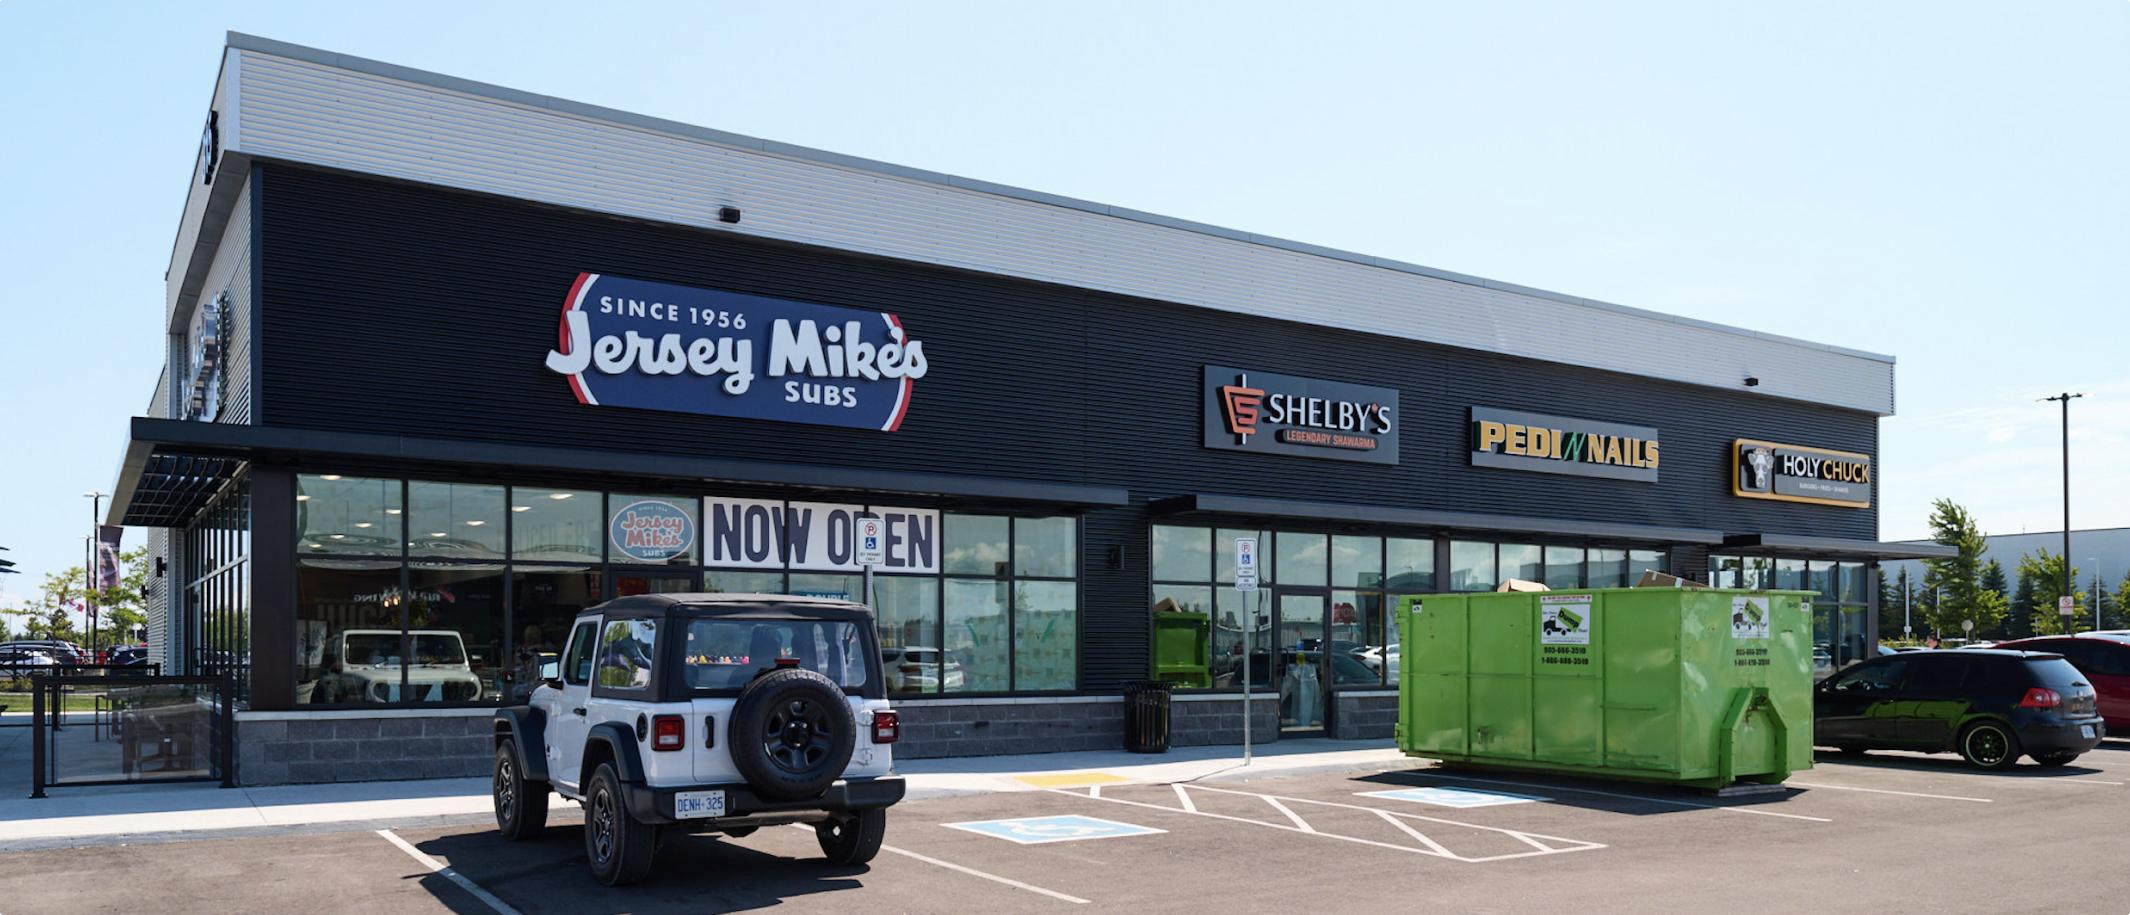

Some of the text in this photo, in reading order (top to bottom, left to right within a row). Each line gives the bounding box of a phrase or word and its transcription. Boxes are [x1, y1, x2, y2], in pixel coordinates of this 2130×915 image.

[600, 296, 747, 330] SINCE 1956
[545, 310, 928, 395] Jersey Mike's
[784, 381, 857, 408] SUBS
[1269, 393, 1392, 434] SHELBY'S
[1286, 429, 1376, 449] LEGENDARY SHAWARMA
[1479, 420, 1562, 460] PEDI
[1587, 433, 1659, 469] NAILS
[1783, 454, 1871, 483] HOLY CHUCK
[621, 511, 684, 535] Jersey
[713, 503, 812, 564] NOW
[642, 549, 666, 557] SUBS
[1558, 608, 1581, 629] Dump
